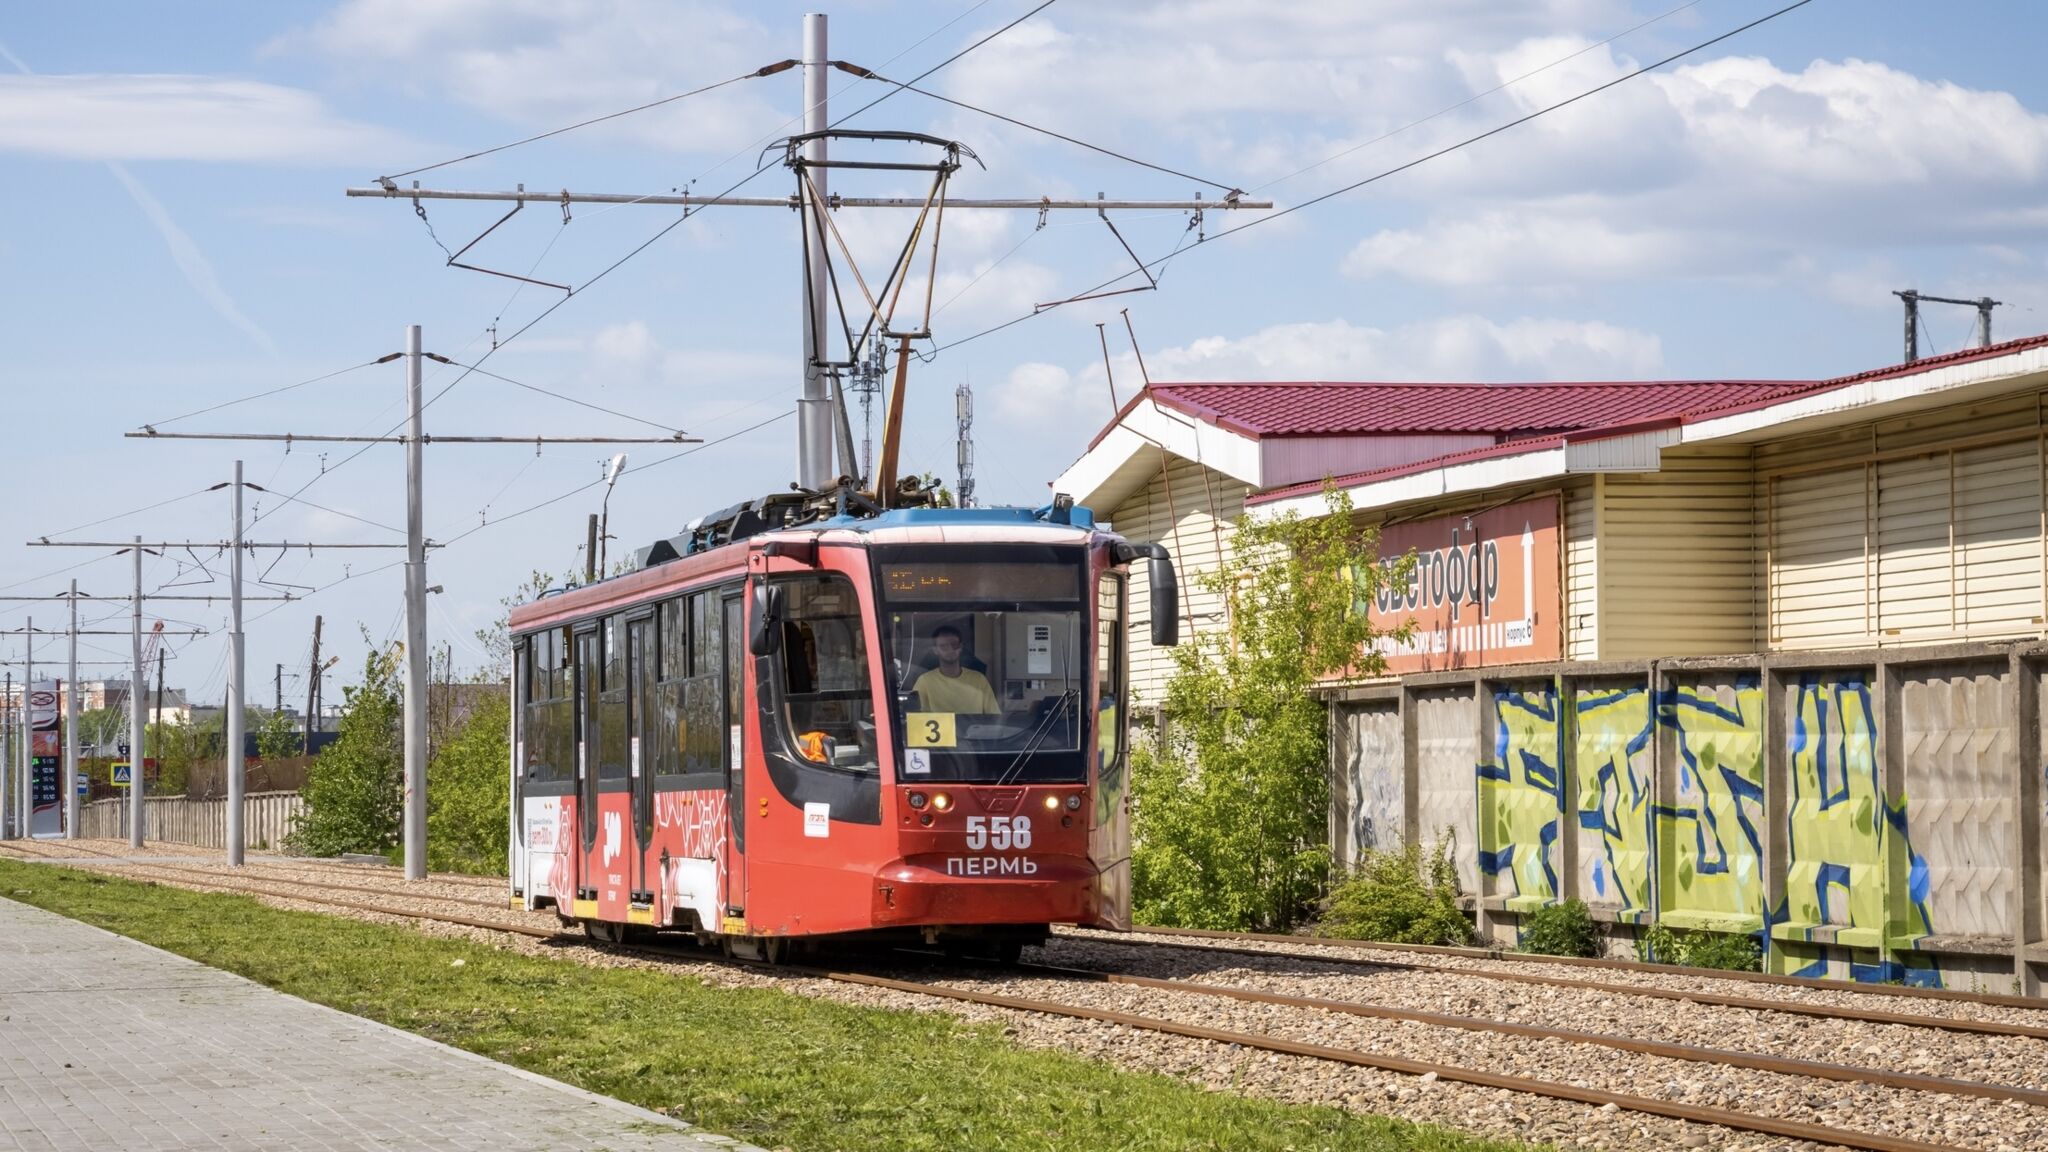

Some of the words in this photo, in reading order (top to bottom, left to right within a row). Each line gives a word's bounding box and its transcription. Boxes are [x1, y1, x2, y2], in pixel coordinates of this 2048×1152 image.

[1527, 618, 1532, 638] 6
[925, 720, 941, 743] 3
[966, 816, 1032, 850] 558
[947, 857, 1038, 875] ПЕРМЬ
